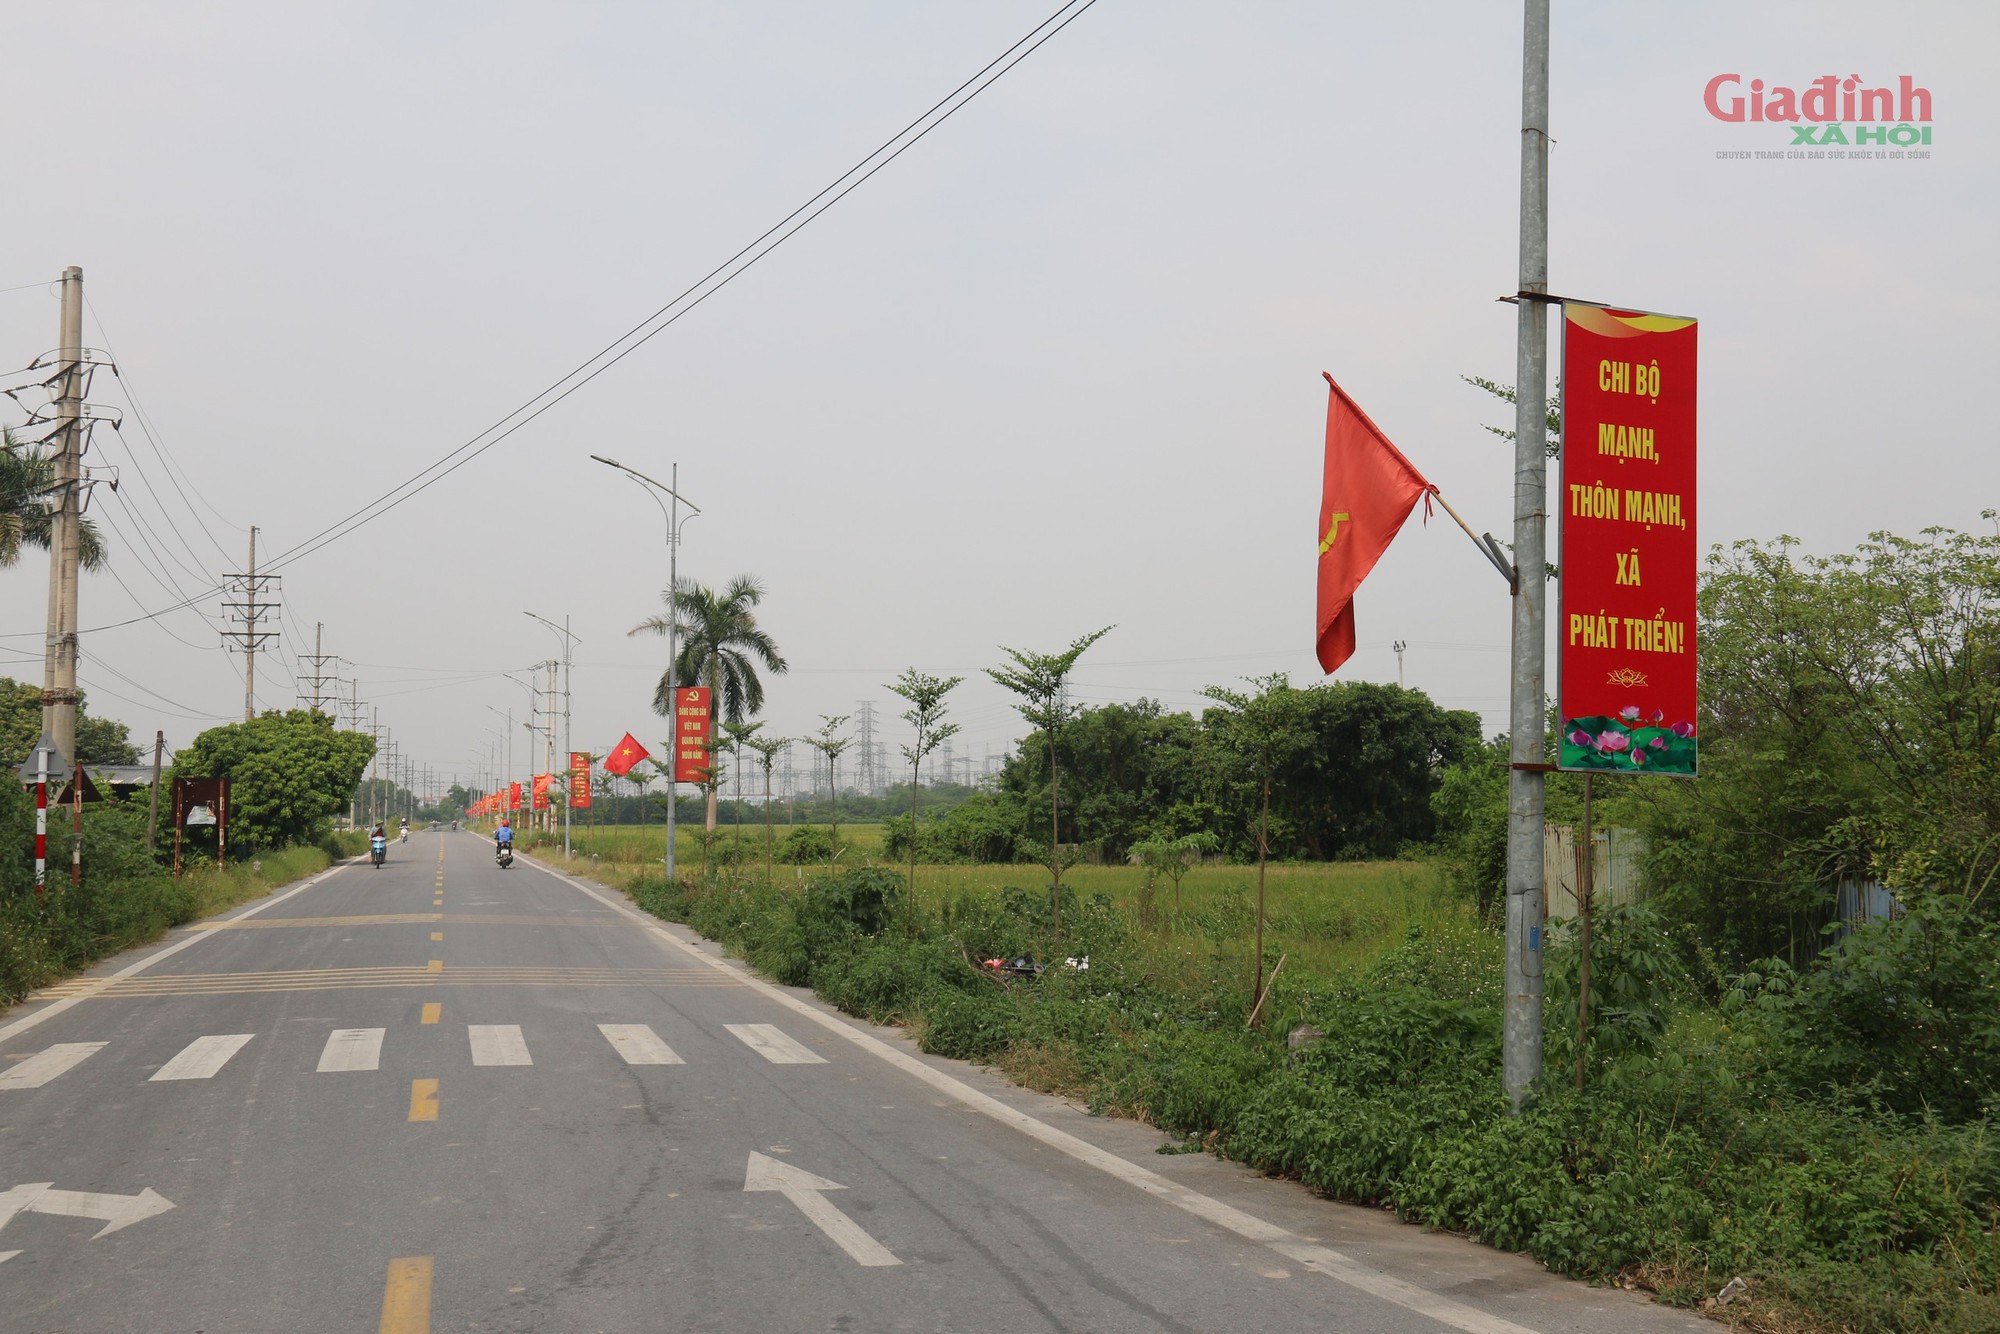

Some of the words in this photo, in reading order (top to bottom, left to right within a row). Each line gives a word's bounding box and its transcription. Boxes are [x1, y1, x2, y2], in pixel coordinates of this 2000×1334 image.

[1599, 359, 1630, 394] CHI
[1635, 359, 1661, 405] BỘ
[1598, 422, 1660, 465] MẠNH,
[1569, 479, 1620, 521] THÔN
[1625, 489, 1686, 532] MẠNH,
[1615, 547, 1642, 587] XÃ
[1570, 608, 1619, 650] PHÁT
[1623, 606, 1685, 654] TRIỂN!
